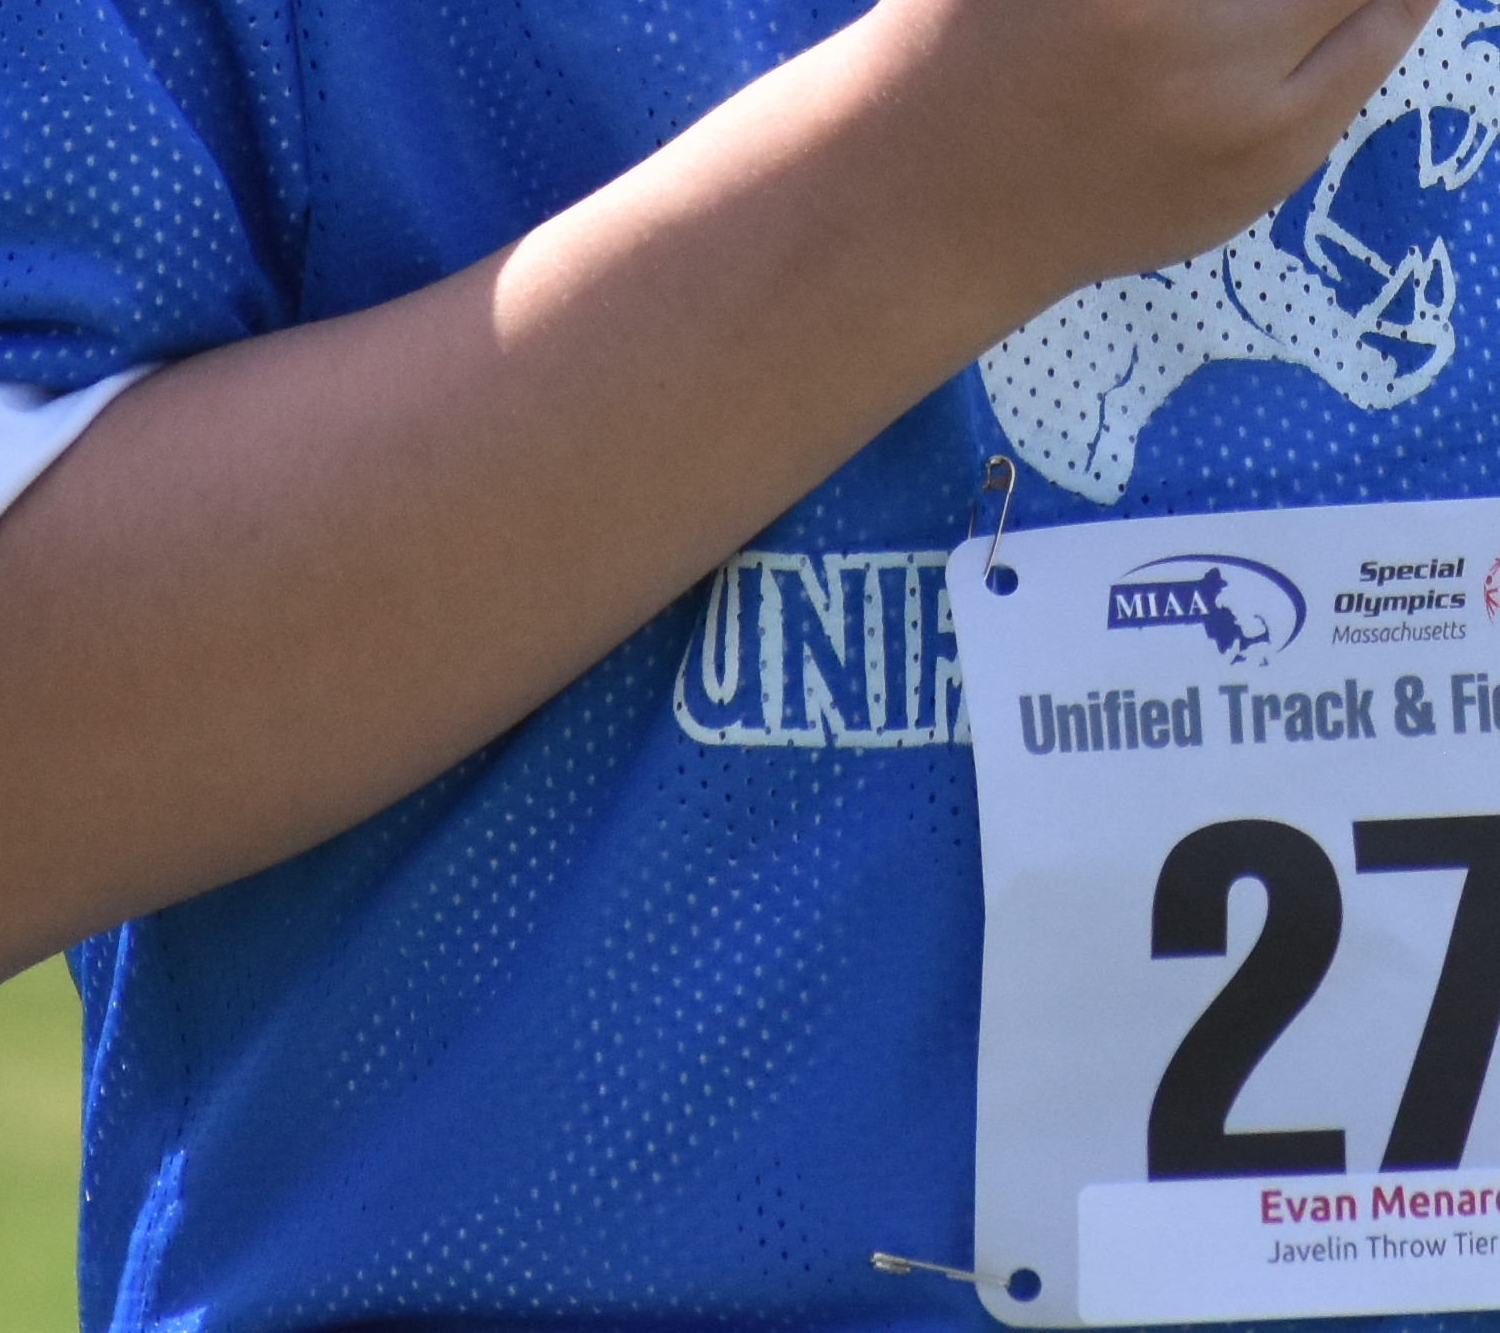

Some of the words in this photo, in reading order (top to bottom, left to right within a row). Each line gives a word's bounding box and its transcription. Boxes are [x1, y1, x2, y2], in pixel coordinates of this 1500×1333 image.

[1360, 557, 1466, 587] Special
[1114, 589, 1211, 621] MIAA
[1333, 589, 1466, 618] Olympics
[1331, 621, 1467, 646] Massachusetts
[1018, 685, 1203, 756] Unified
[1219, 678, 1377, 745] Track
[1393, 673, 1437, 740] &
[1260, 1188, 1358, 1225] Evan
[1267, 1235, 1358, 1265] Javelin
[1366, 1233, 1447, 1259] Throw
[1454, 1230, 1499, 1256] Tier
